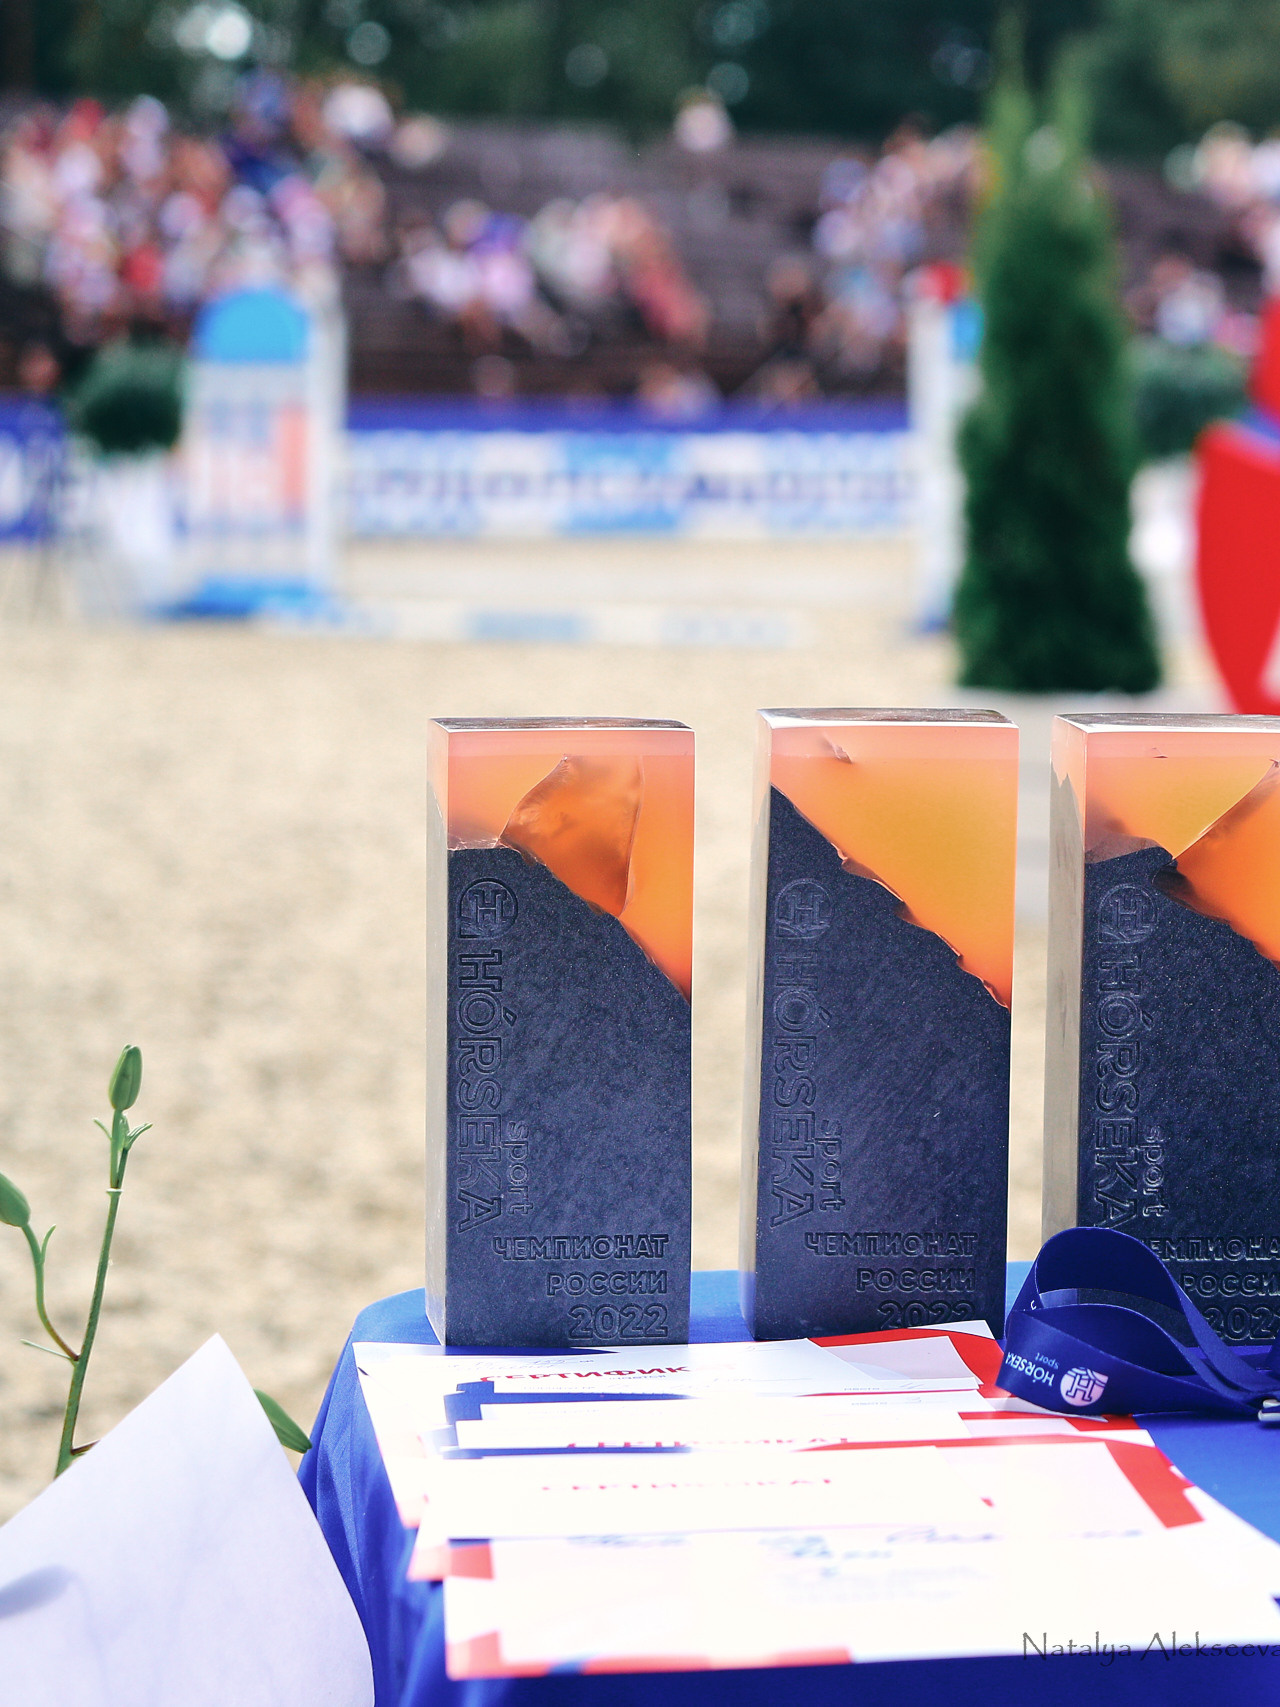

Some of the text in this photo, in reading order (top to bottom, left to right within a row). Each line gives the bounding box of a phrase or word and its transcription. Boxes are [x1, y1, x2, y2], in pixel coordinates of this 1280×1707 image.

[457, 949, 518, 1234] HÓRSEKA
[506, 1121, 535, 1216] sport
[819, 1117, 847, 1212] sport
[1142, 1124, 1169, 1219] sport
[491, 1234, 670, 1261] ЧЕМПИОНАТ
[803, 1231, 979, 1258] ЧЕМПИОНАТ
[546, 1269, 669, 1297] РОССИИ
[855, 1266, 977, 1293] РОССИИ
[568, 1304, 669, 1340] 2022
[480, 1364, 736, 1382] СЕРТИФИК
[1005, 1351, 1056, 1387] HÓRSEKA
[1034, 1352, 1060, 1371] sport
